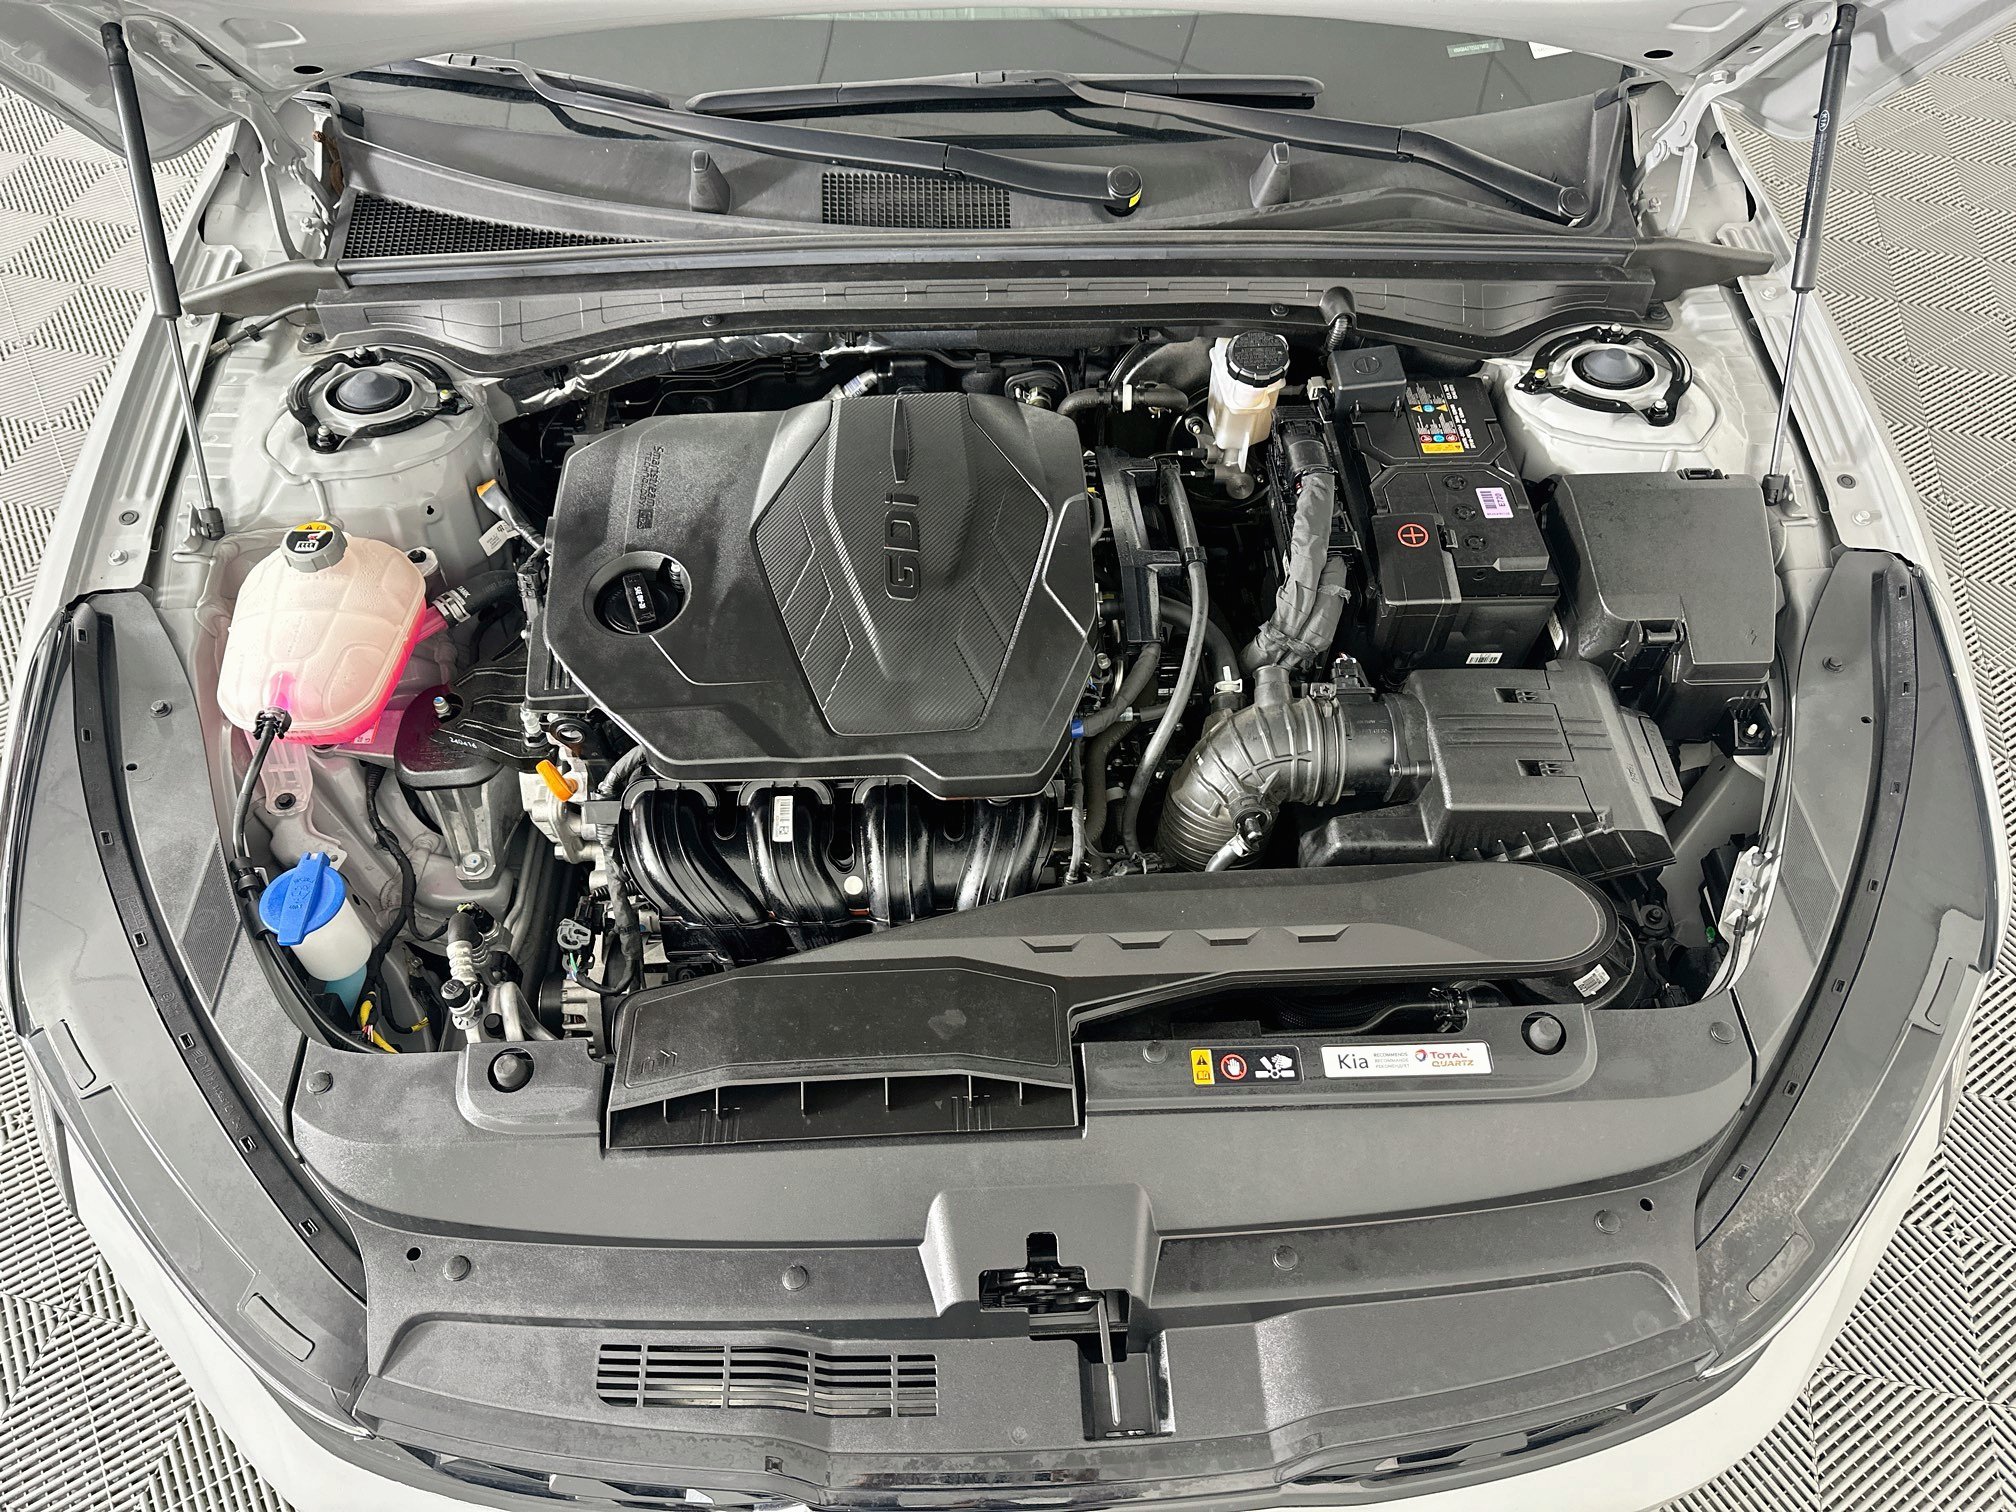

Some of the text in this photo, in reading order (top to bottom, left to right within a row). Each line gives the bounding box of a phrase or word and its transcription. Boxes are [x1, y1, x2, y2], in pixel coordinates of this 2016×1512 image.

[1819, 112, 1829, 129] KIA
[647, 445, 664, 507] Smartstream
[457, 585, 471, 598] TANK
[1337, 1054, 1369, 1070] Kia
[1430, 1051, 1468, 1060] TOTAL
[1431, 1060, 1475, 1068] QUARTZ
